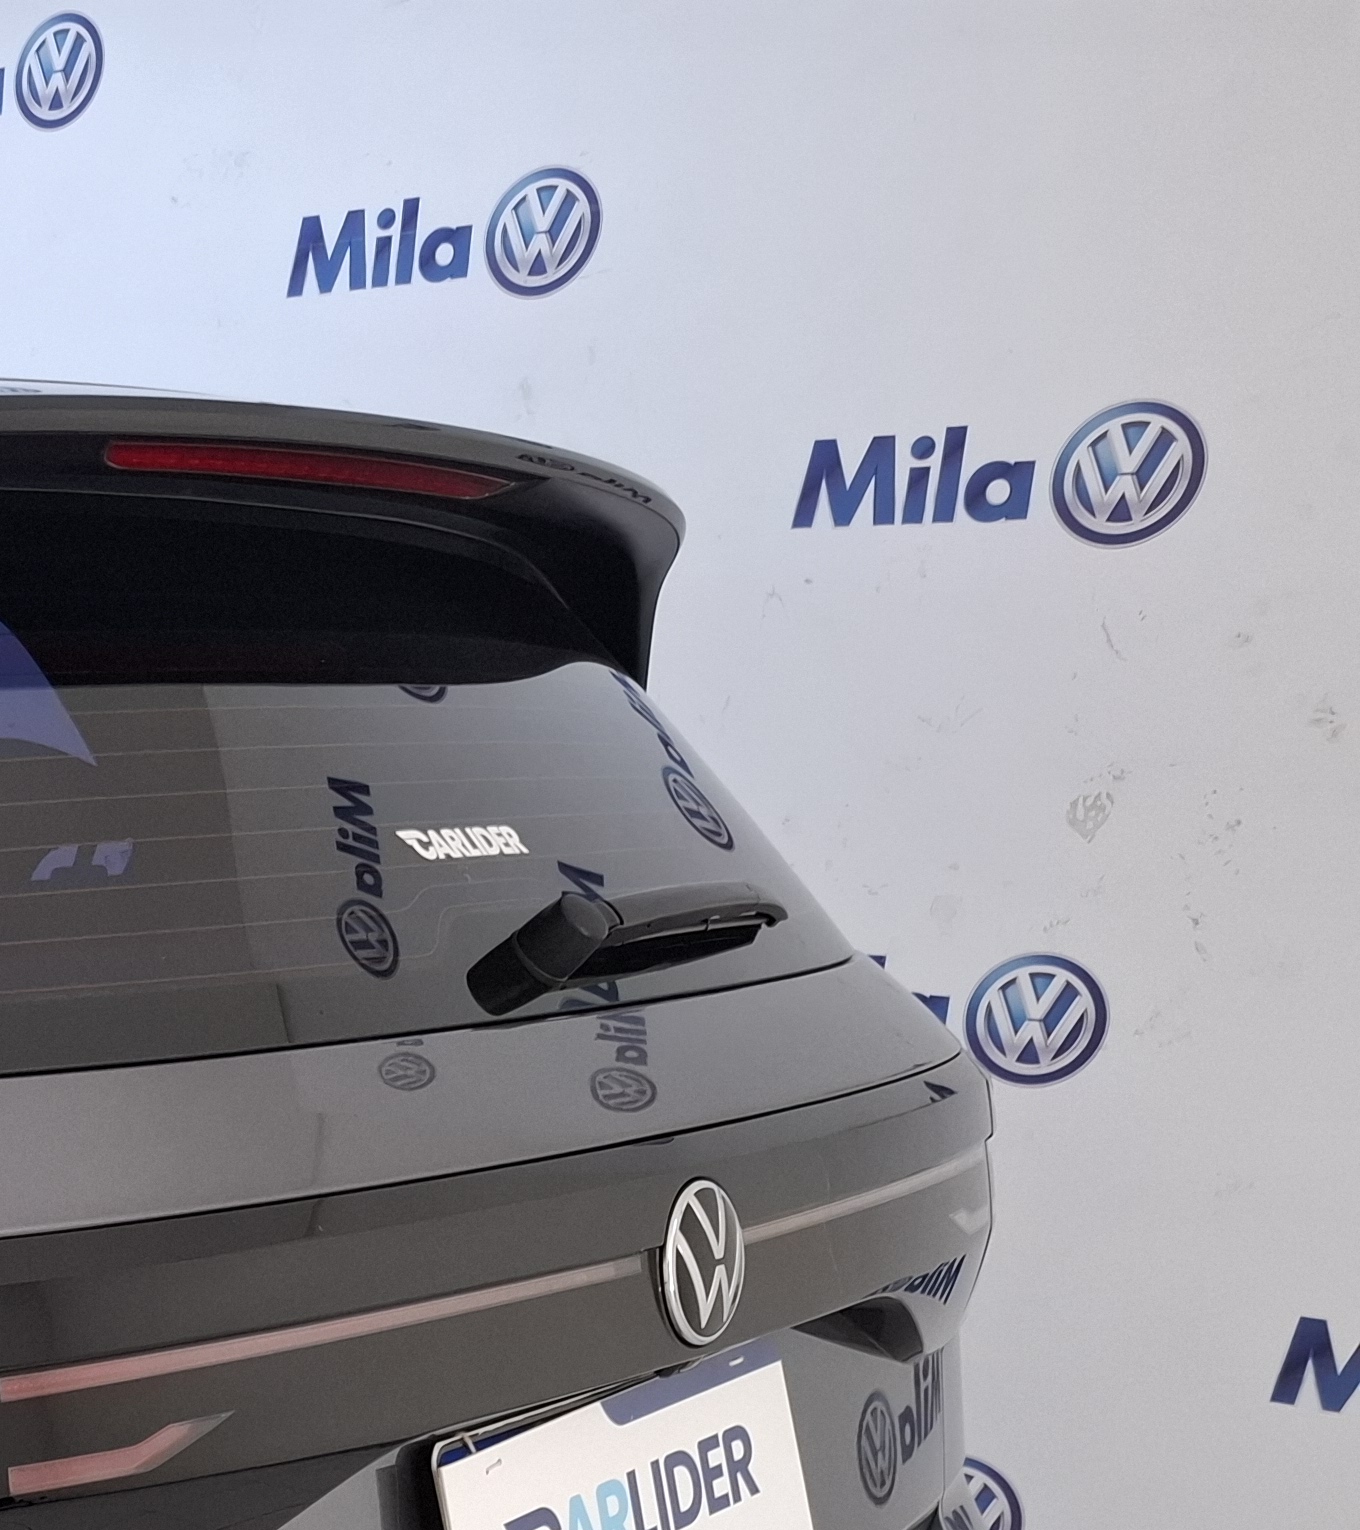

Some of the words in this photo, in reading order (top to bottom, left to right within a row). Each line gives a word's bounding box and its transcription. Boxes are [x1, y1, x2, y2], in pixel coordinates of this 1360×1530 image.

[286, 197, 472, 298] Mila
[790, 425, 1035, 530] Mila
[396, 825, 529, 861] CARLIDER
